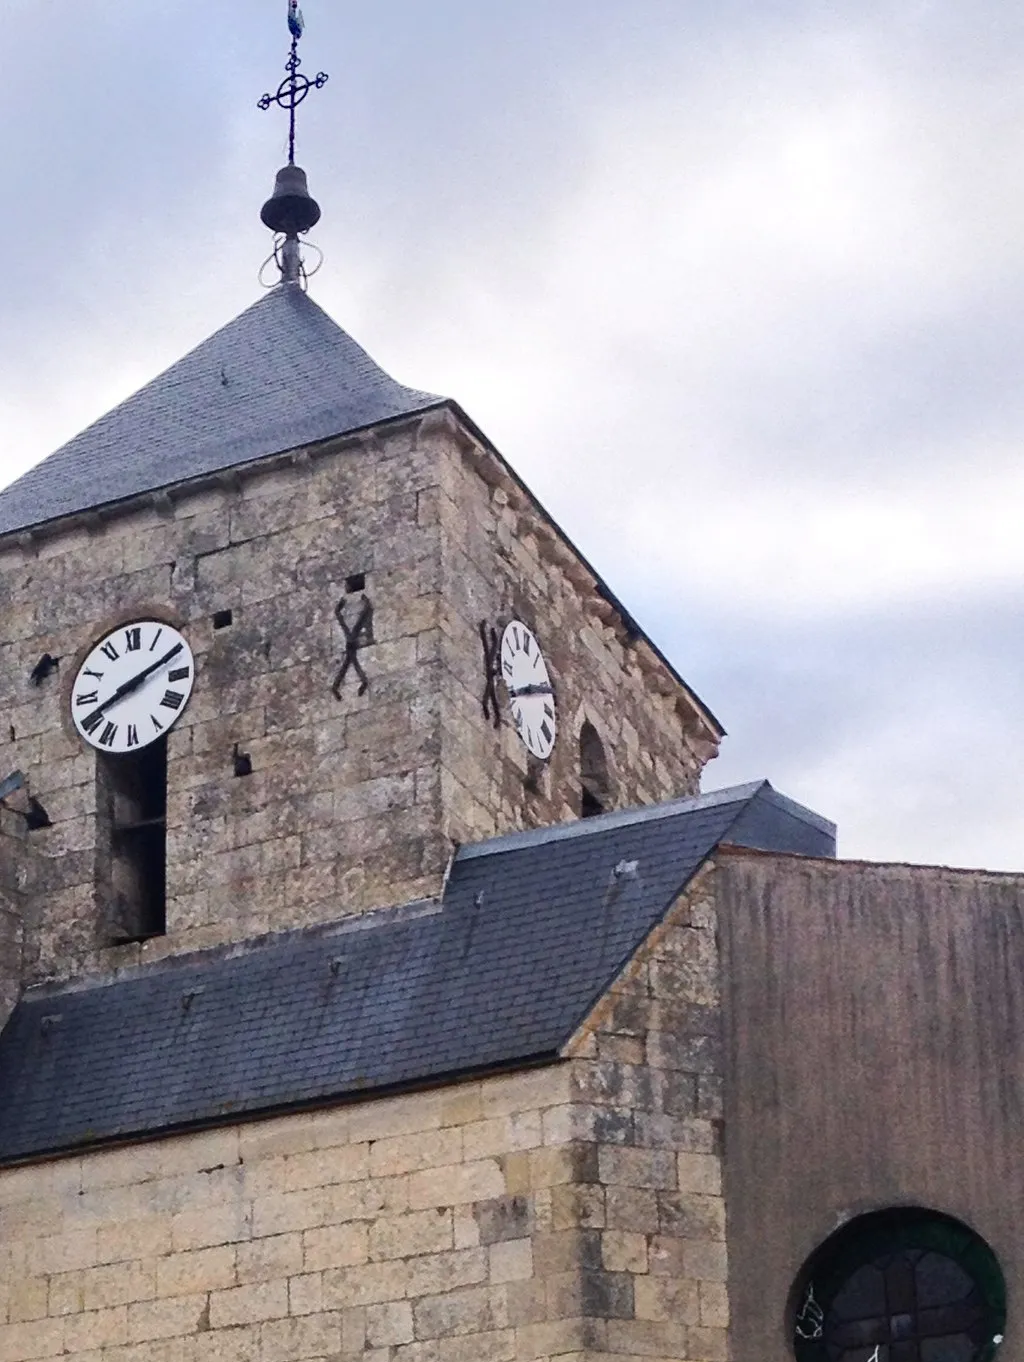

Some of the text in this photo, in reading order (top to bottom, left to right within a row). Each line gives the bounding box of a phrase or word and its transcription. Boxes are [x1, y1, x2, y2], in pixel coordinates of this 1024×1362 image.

[125, 627, 142, 653] XII
[149, 628, 162, 651] I
[82, 667, 104, 681] X
